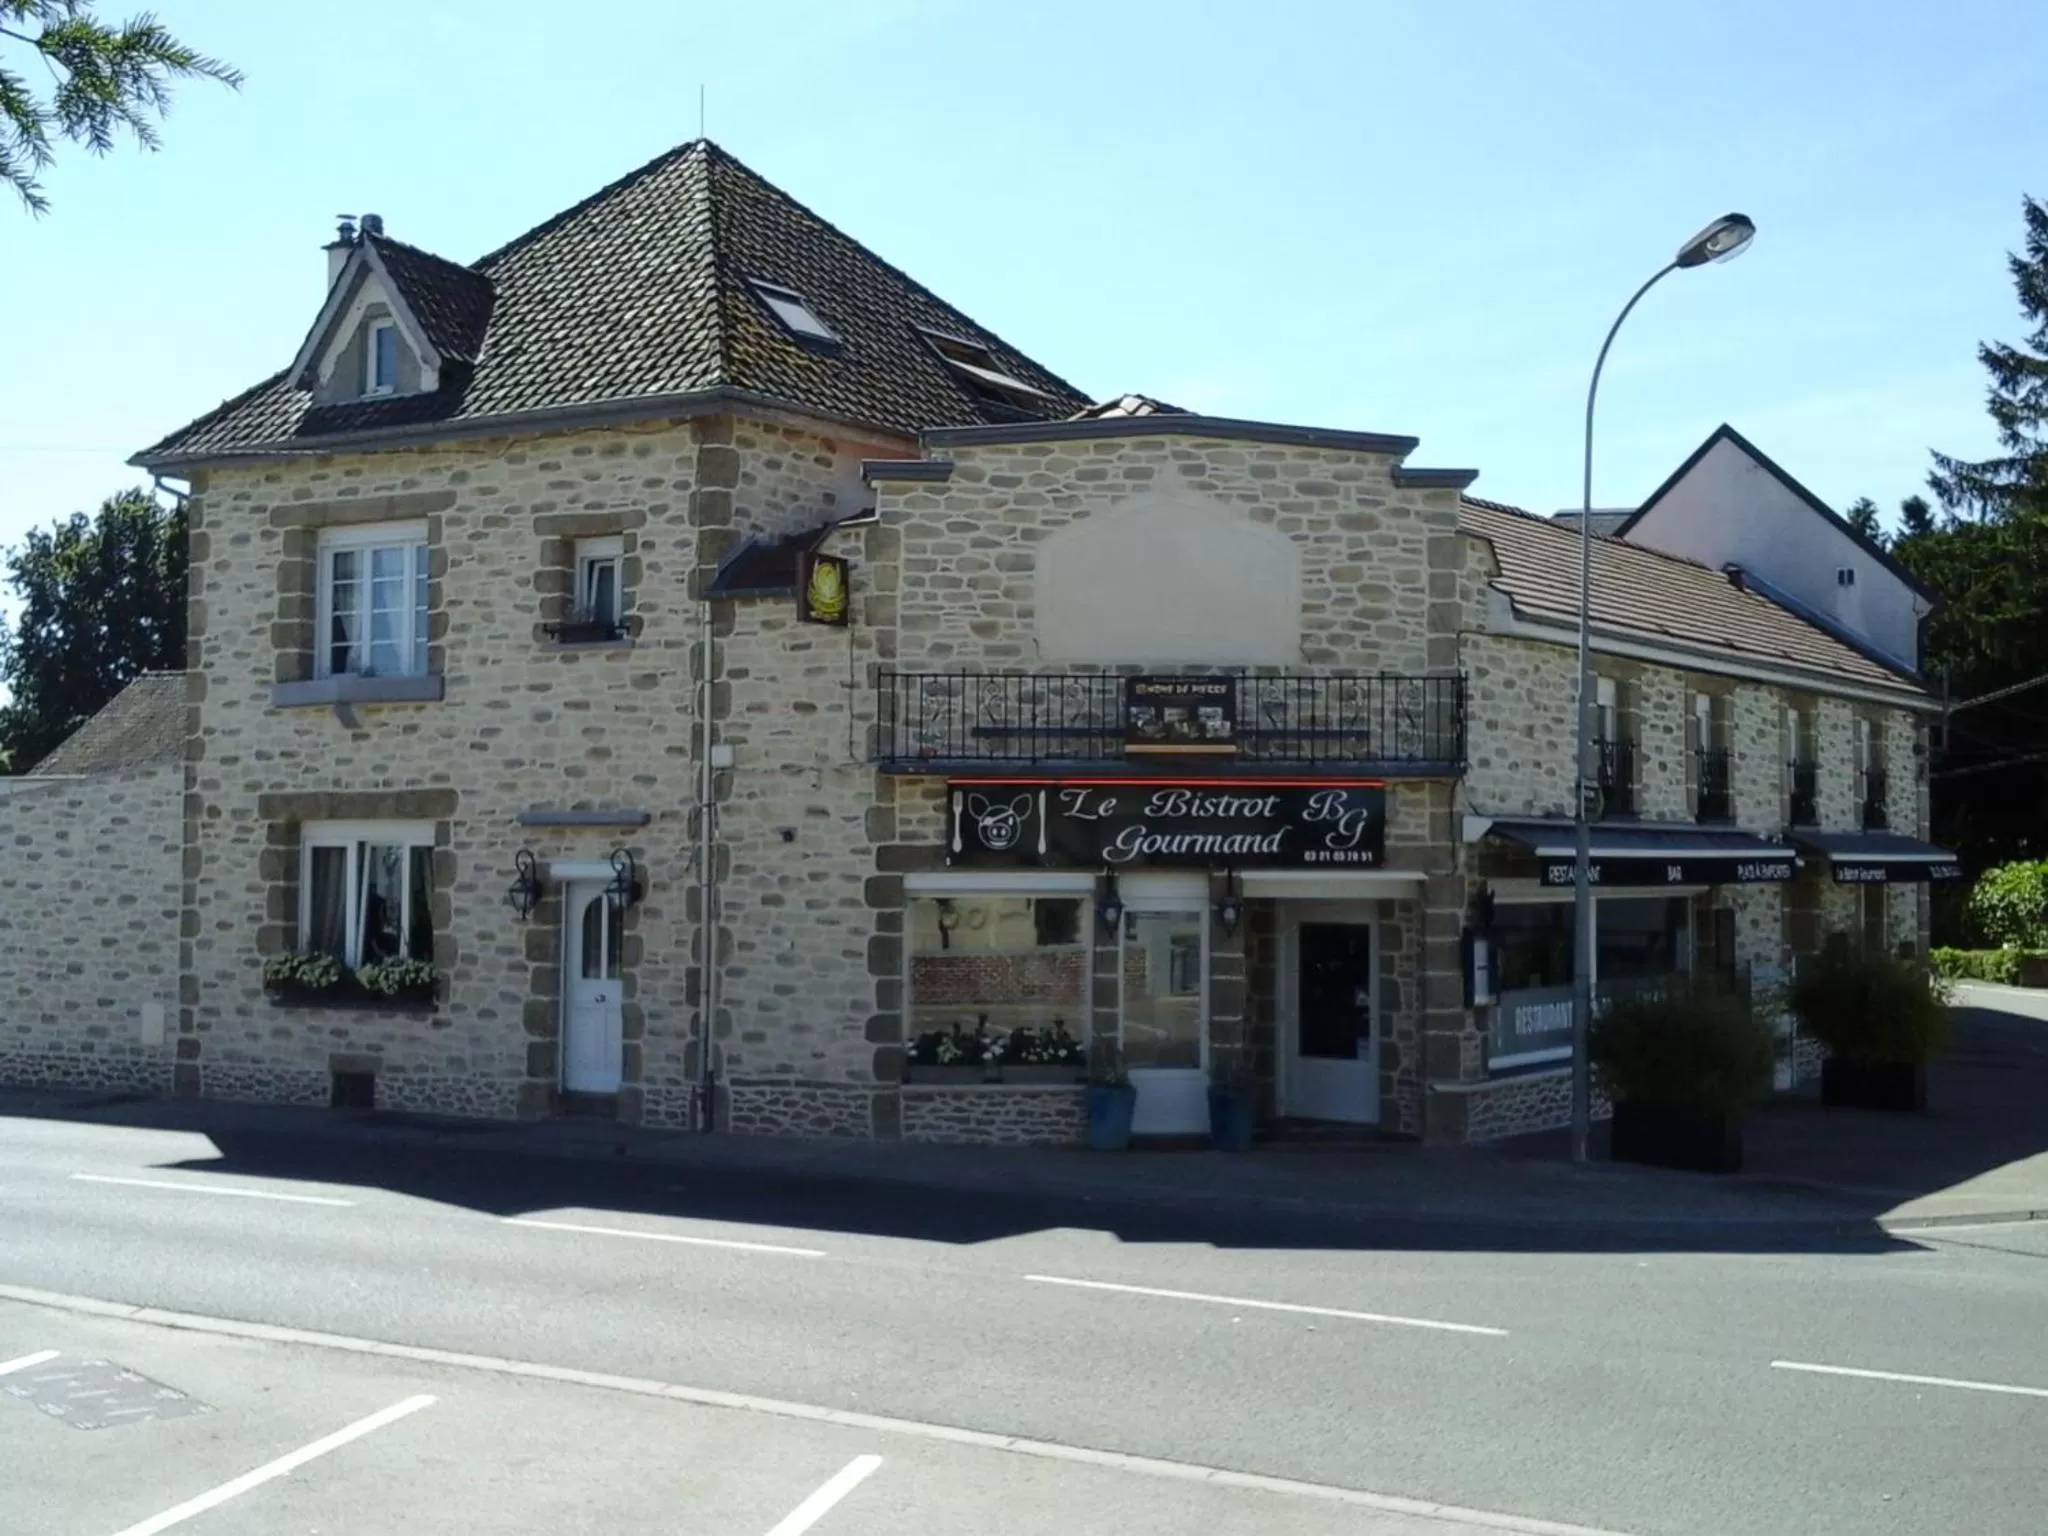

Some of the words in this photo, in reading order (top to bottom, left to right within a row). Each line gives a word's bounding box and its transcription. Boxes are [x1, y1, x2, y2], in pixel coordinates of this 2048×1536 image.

[1059, 788, 1118, 820] Le
[1143, 788, 1281, 819] Bistrot
[1102, 823, 1294, 864] Gourmand
[1548, 864, 1601, 884] RESTAANT
